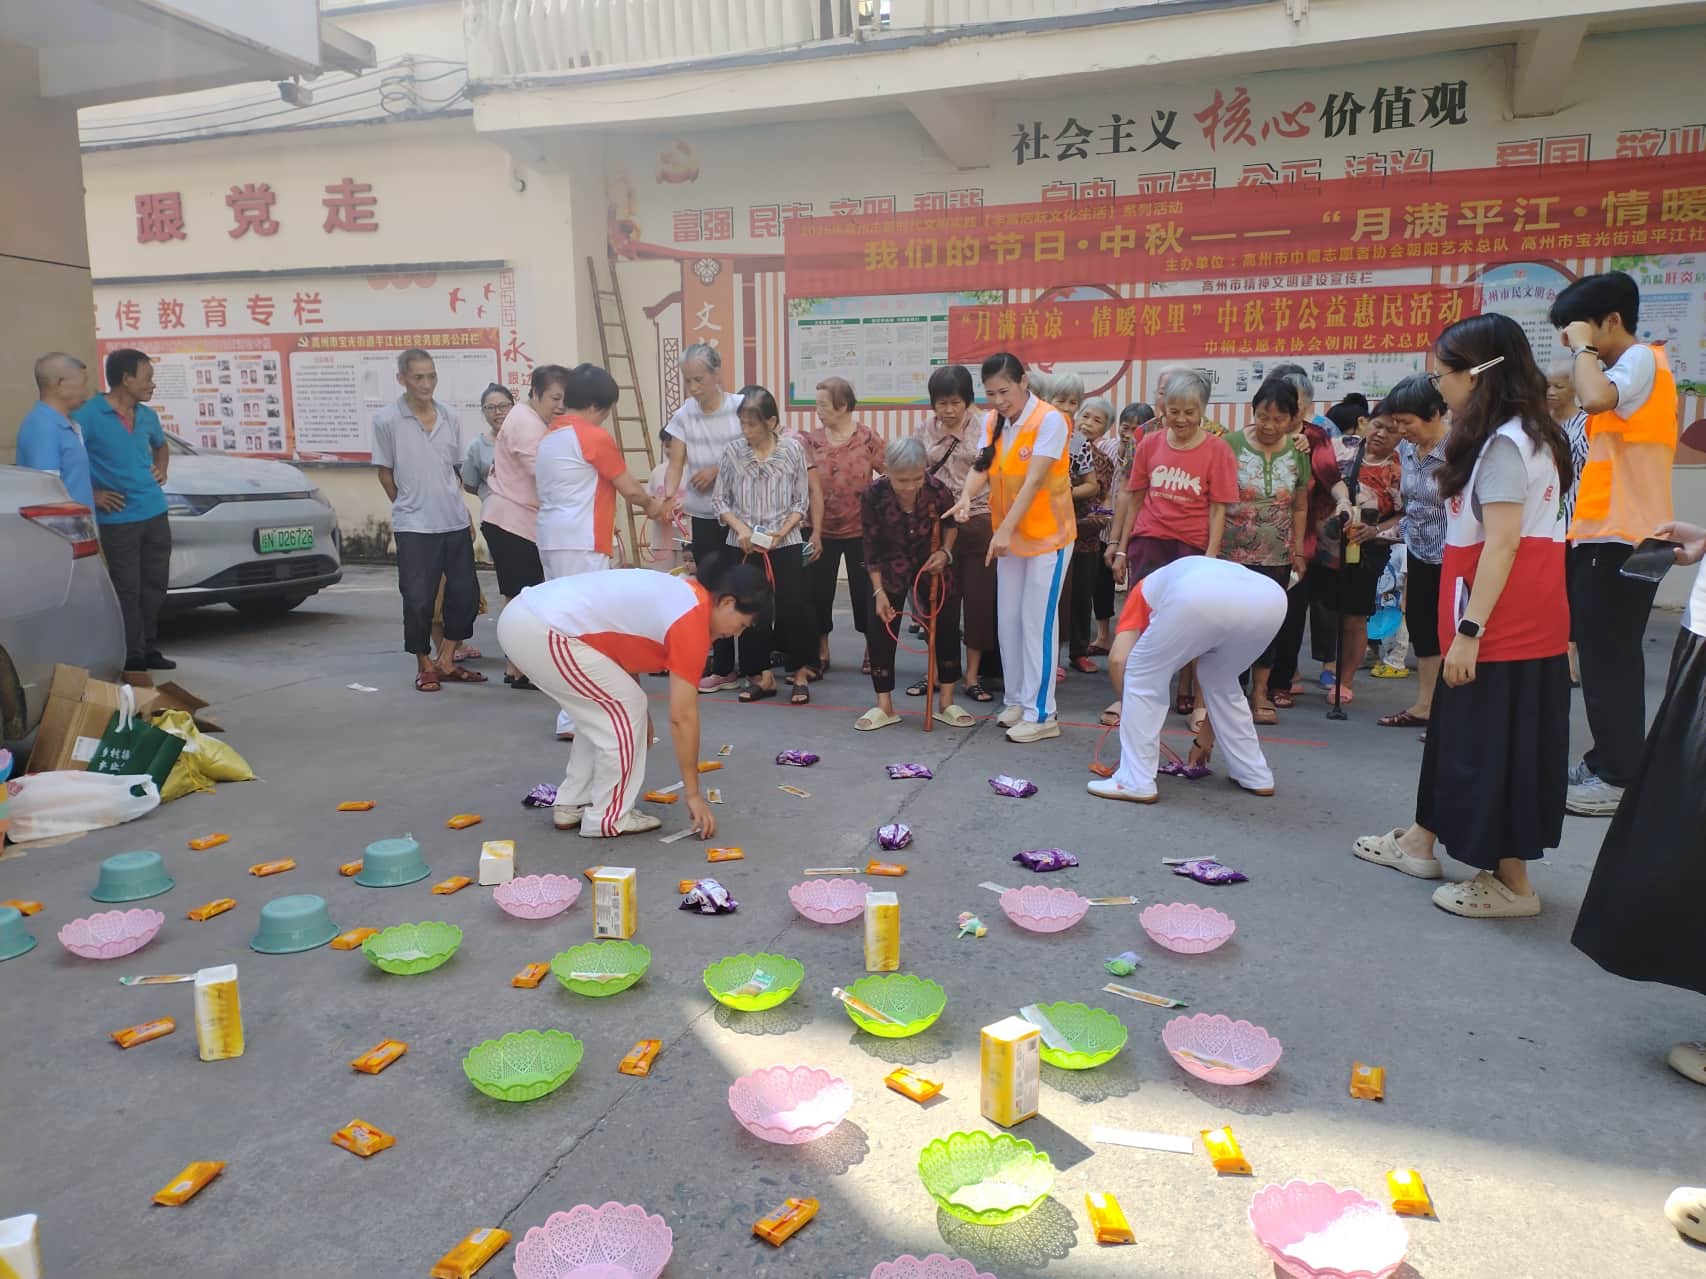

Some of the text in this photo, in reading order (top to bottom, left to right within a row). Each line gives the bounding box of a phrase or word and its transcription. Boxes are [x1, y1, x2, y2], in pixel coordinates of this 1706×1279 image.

[1012, 80, 1469, 166] 社会主义核心价值观
[134, 177, 380, 244] 跟党走
[672, 206, 734, 242] 富强
[94, 291, 324, 332] 传教育专栏
